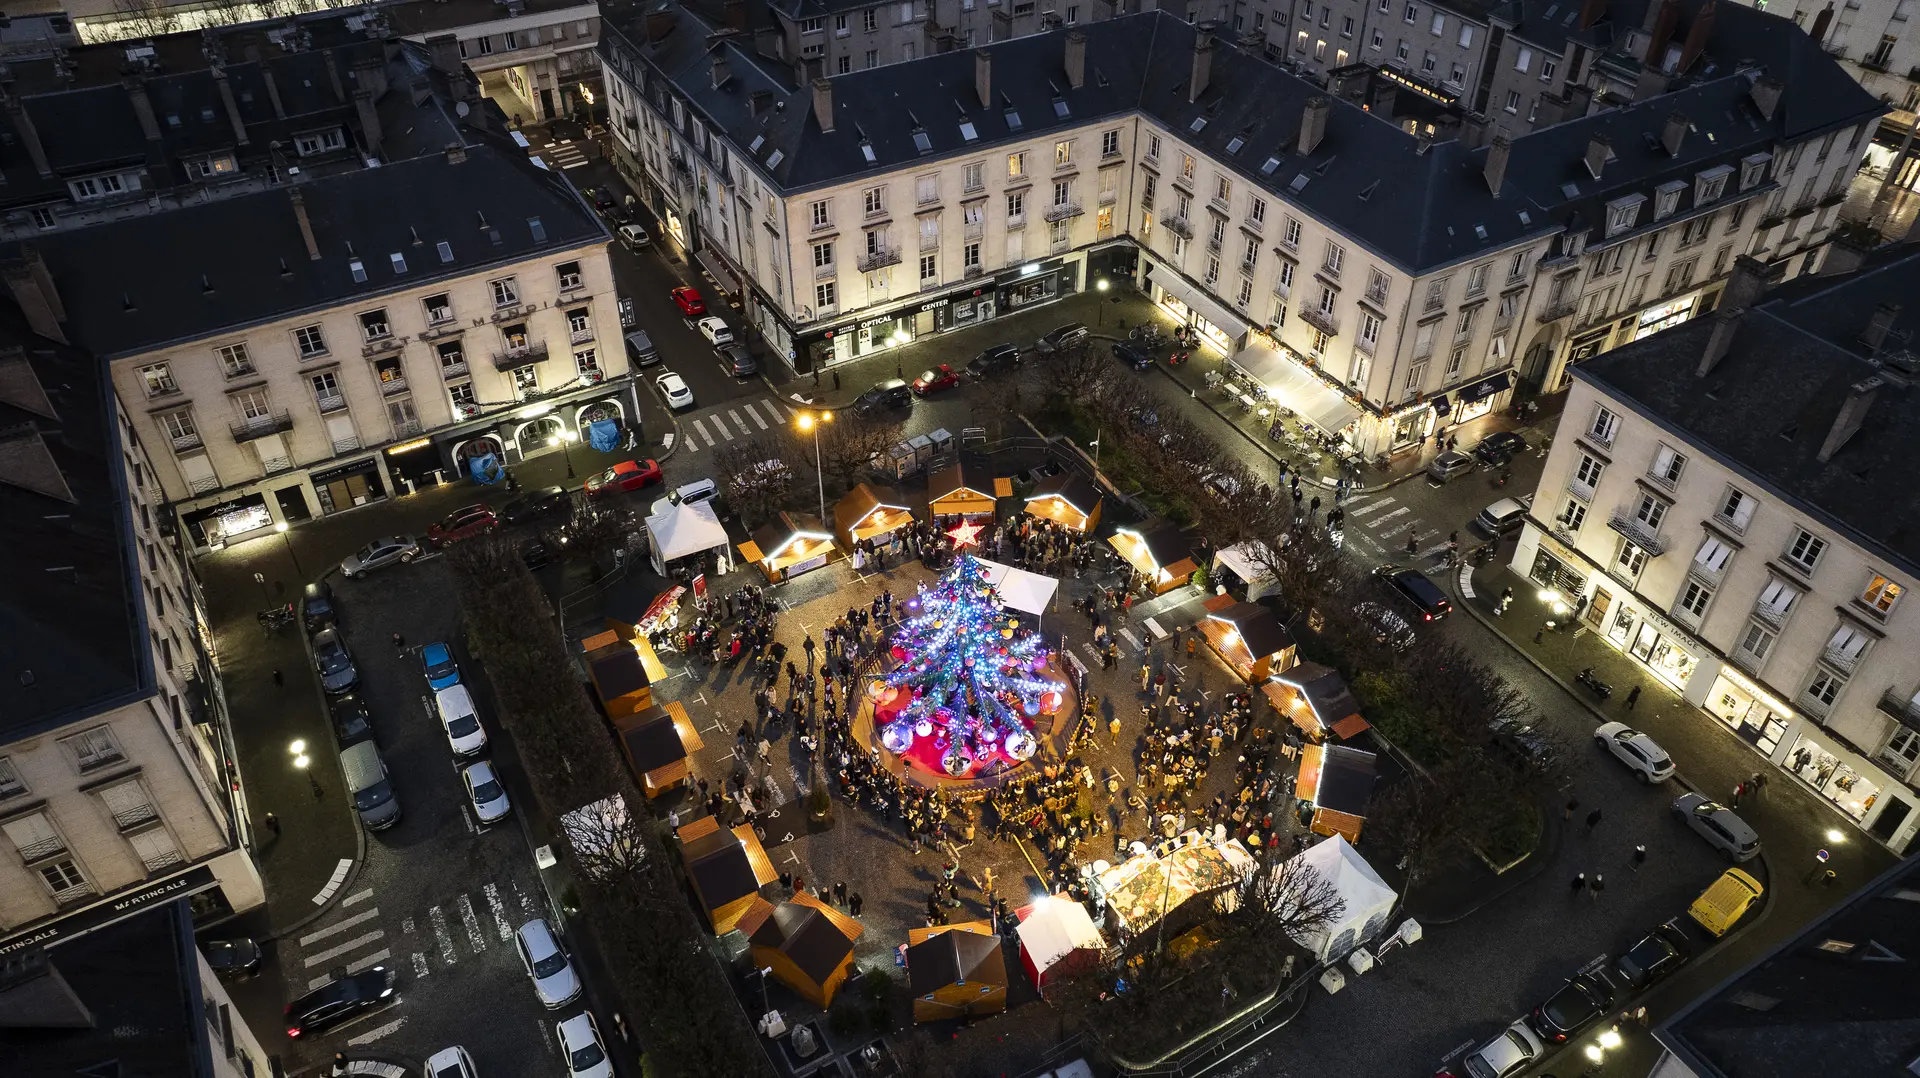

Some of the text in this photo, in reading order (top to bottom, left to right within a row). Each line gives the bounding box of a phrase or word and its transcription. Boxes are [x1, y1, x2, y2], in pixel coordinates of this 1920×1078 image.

[861, 299, 949, 328] OPTICAL CENTER
[1649, 613, 1699, 651] NEW IMAGE
[114, 879, 188, 911] MARTINGALE
